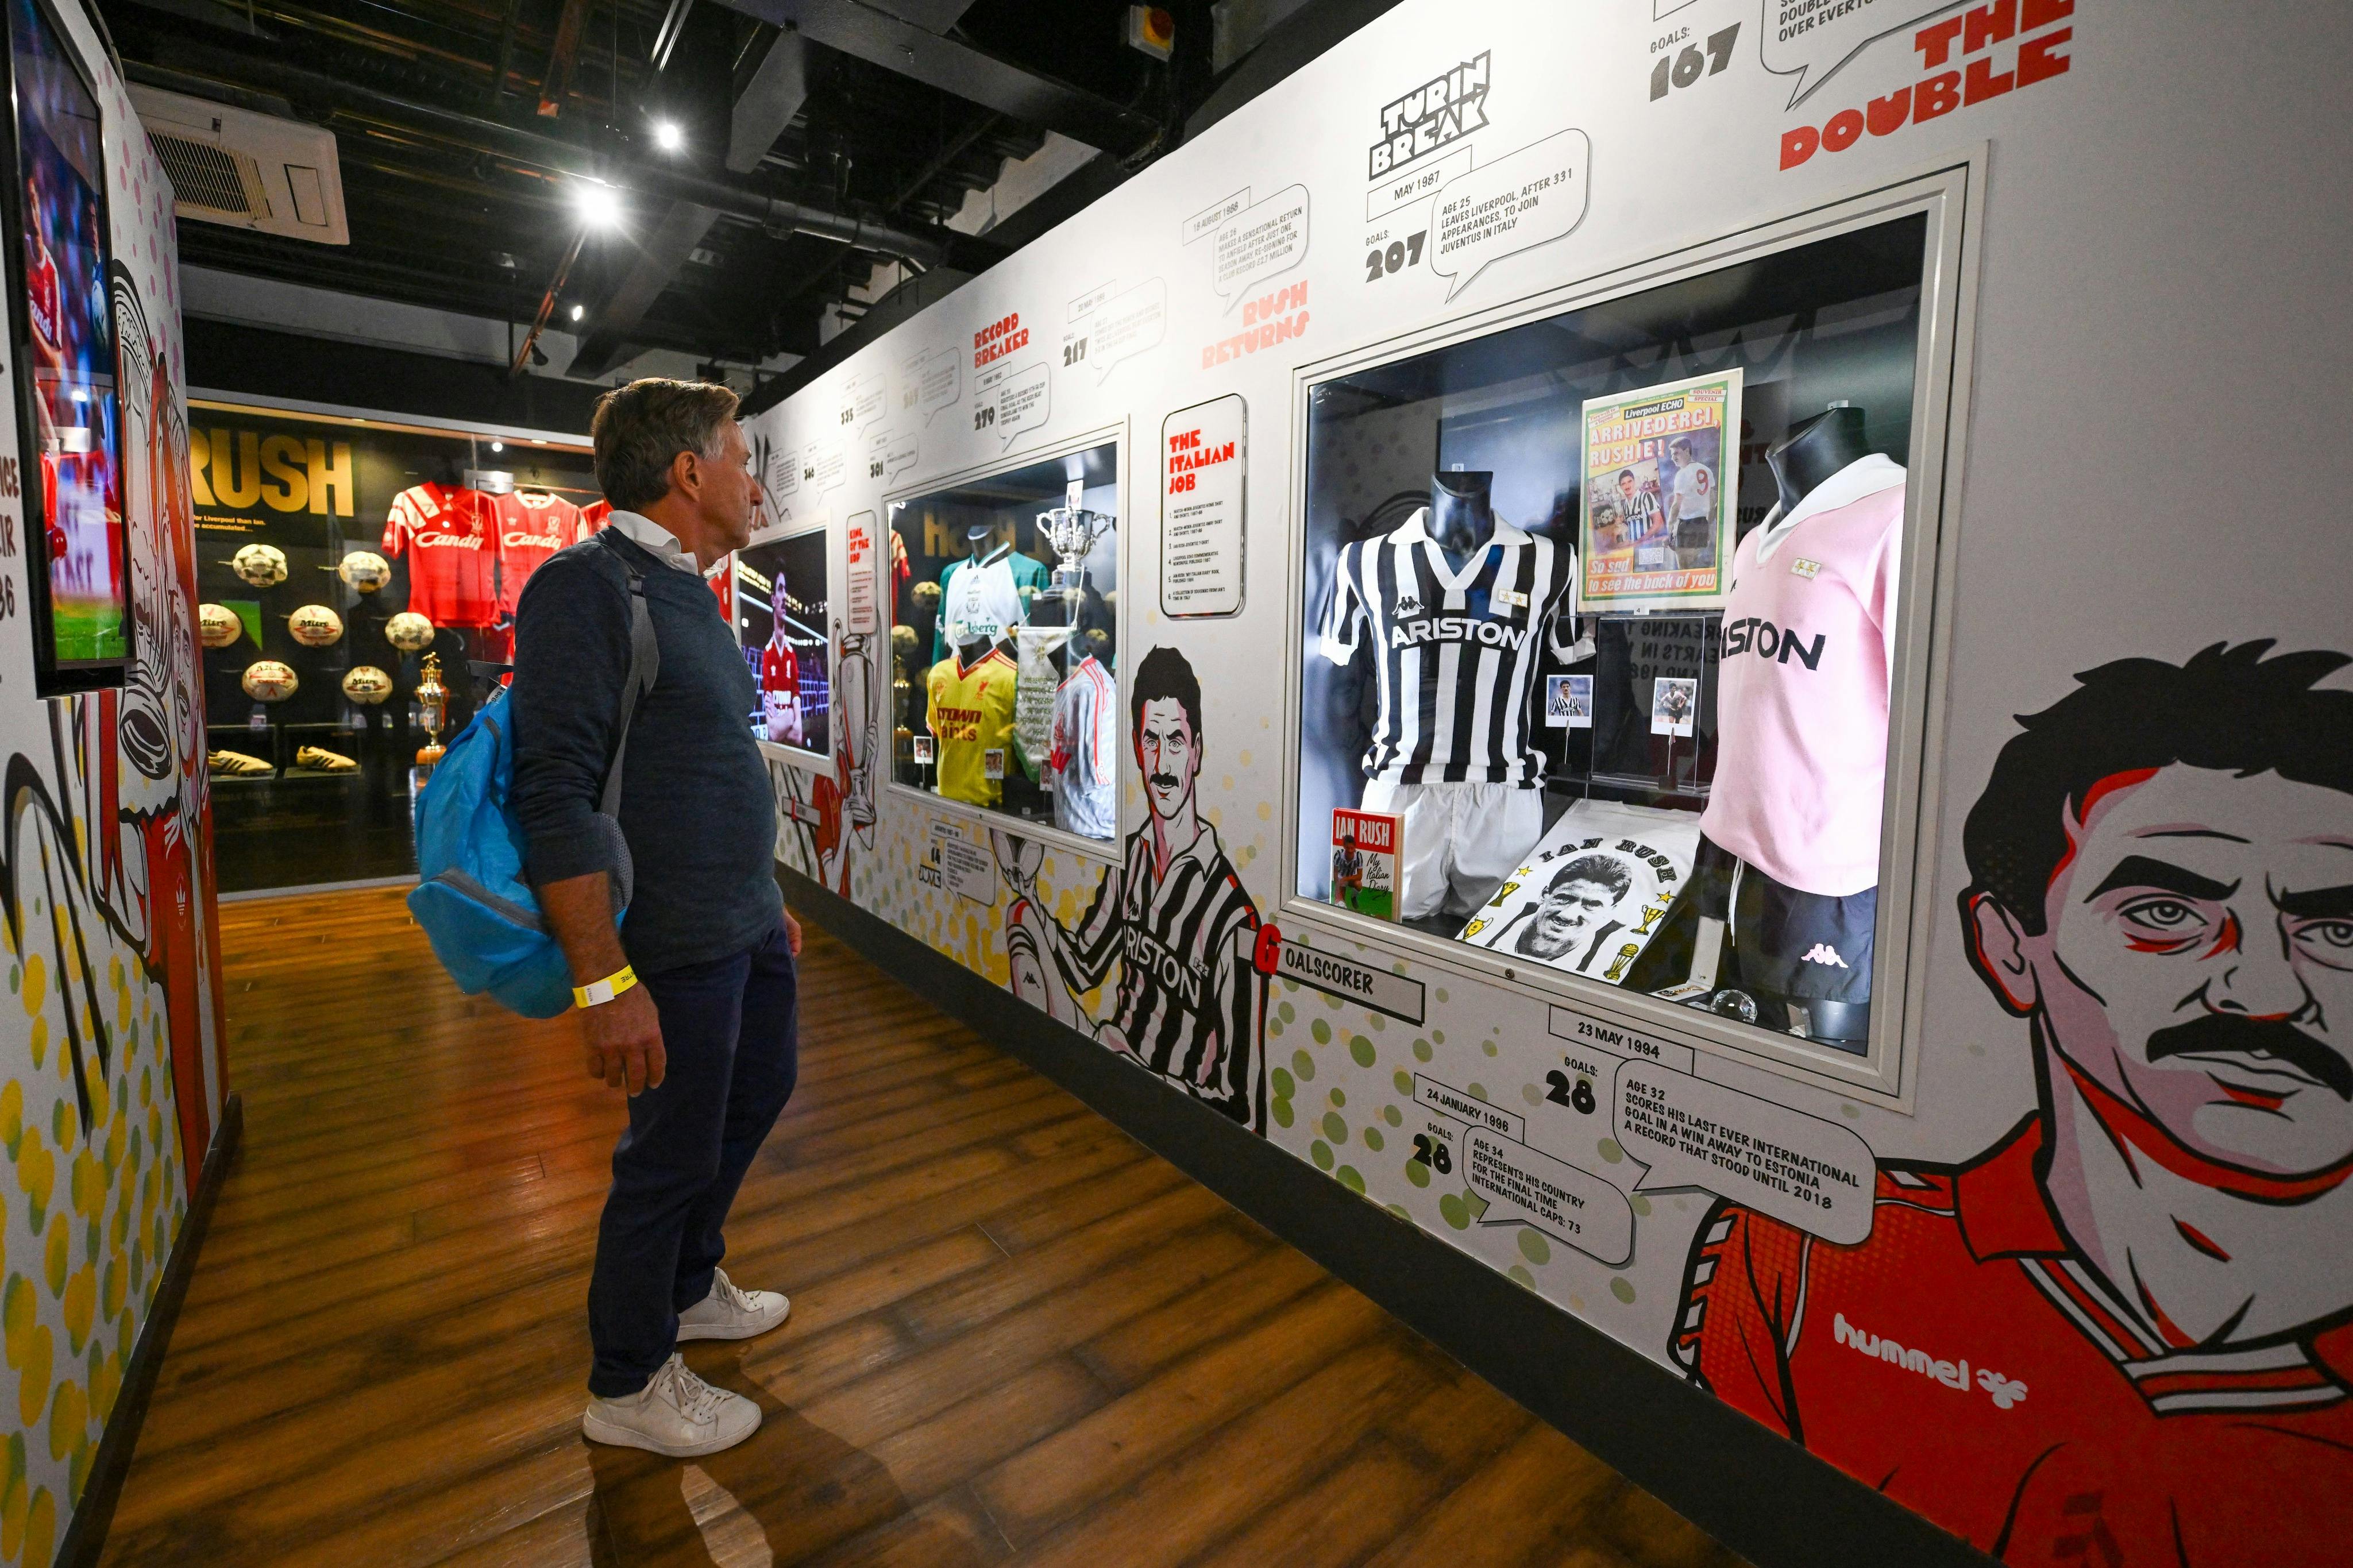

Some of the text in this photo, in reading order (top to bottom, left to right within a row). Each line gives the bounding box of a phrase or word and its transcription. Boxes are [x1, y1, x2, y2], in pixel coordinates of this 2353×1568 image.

[1650, 26, 1691, 53] GOALS:
[1779, 0, 1878, 42] OVER EVERT
[1915, 0, 2074, 70] THE
[1650, 21, 1741, 102] 167
[1382, 49, 1491, 136] TURIN
[1780, 26, 2073, 171] DOUBLE
[1369, 86, 1490, 180] BREAK
[1394, 171, 1440, 200] MAY 1987
[1441, 168, 1572, 229] LEAVES LIVERPOOL, AFTER 331
[1202, 210, 1222, 228] AUGUST
[1441, 195, 1539, 241] APPEARANCES, TO JOIN
[1442, 196, 1471, 216] AGE 25
[1218, 240, 1237, 253] MAKES
[1243, 218, 1278, 242] SENSATIONAL
[1279, 206, 1302, 224] RETURN
[1226, 245, 1247, 260] ANFIELD
[1248, 235, 1265, 249] AFTER
[1266, 229, 1279, 241] JUST
[1280, 222, 1292, 234] ONE
[1365, 230, 1390, 247] GOALS:
[1441, 217, 1518, 254] JUVENTUS IN ITALY
[1218, 260, 1237, 273] SEASON
[1254, 237, 1285, 257] RE-SIGNING
[1286, 230, 1298, 242] FOR
[1236, 260, 1256, 276] RECORD
[1270, 243, 1293, 261] MILLION
[1365, 229, 1427, 283] 207
[1243, 279, 1308, 328] RUSH
[974, 312, 1019, 350] RECORD
[974, 327, 1029, 369] BREAKER
[1202, 310, 1310, 370] RETURNS
[1064, 337, 1088, 368] 217
[975, 406, 995, 431] 279
[1590, 406, 1721, 446] ARRIVEDERCI,
[1625, 399, 1683, 419] Liverpool ECHO
[1169, 428, 1201, 453] THE
[1170, 441, 1235, 473] ITALIAN
[190, 426, 354, 517] RUSH
[1170, 473, 1195, 495] JOB
[1696, 469, 1711, 496] 9
[204, 515, 236, 523] Liverpool
[415, 531, 484, 551] Candy
[503, 532, 562, 550] Candy
[1588, 572, 1715, 592] to see the back of you
[1591, 558, 1630, 574] So sad
[1391, 617, 1526, 651] ARISTON
[491, 691, 502, 702] Bag
[1336, 816, 1390, 847] IAN RUSH
[1367, 853, 1380, 872] My
[1367, 867, 1390, 880] Italian
[1538, 837, 1677, 883] IAN RUSH
[1368, 879, 1390, 897] Diary
[1577, 1021, 1660, 1059] 23 MAY 1994
[1564, 1056, 1598, 1077] GOALS:
[1545, 1069, 1596, 1115] 28
[1626, 1079, 1665, 1101] AGE 32
[1427, 1088, 1509, 1133] 24 JANUARY 1996
[1428, 1122, 1453, 1142] GOALS:
[1473, 1138, 1503, 1158] AGE 34
[1625, 1106, 1820, 1190] GOAL IN A WIN AWAY TO ESTONIA
[1626, 1092, 1860, 1188] SCORES HIS LAST EVER INTERNATIONAL
[1413, 1133, 1452, 1175] 28
[1624, 1119, 1833, 1210] A RECORD THAT STOOD UNTIL 2018
[1473, 1149, 1585, 1209] REPRESENTS HIS COUNTRY
[1473, 1161, 1558, 1210] FOR THE FINAL TIME
[1472, 1173, 1581, 1234] INTERNATIONAL CAPS: 73
[1834, 1312, 1970, 1392] hummel
